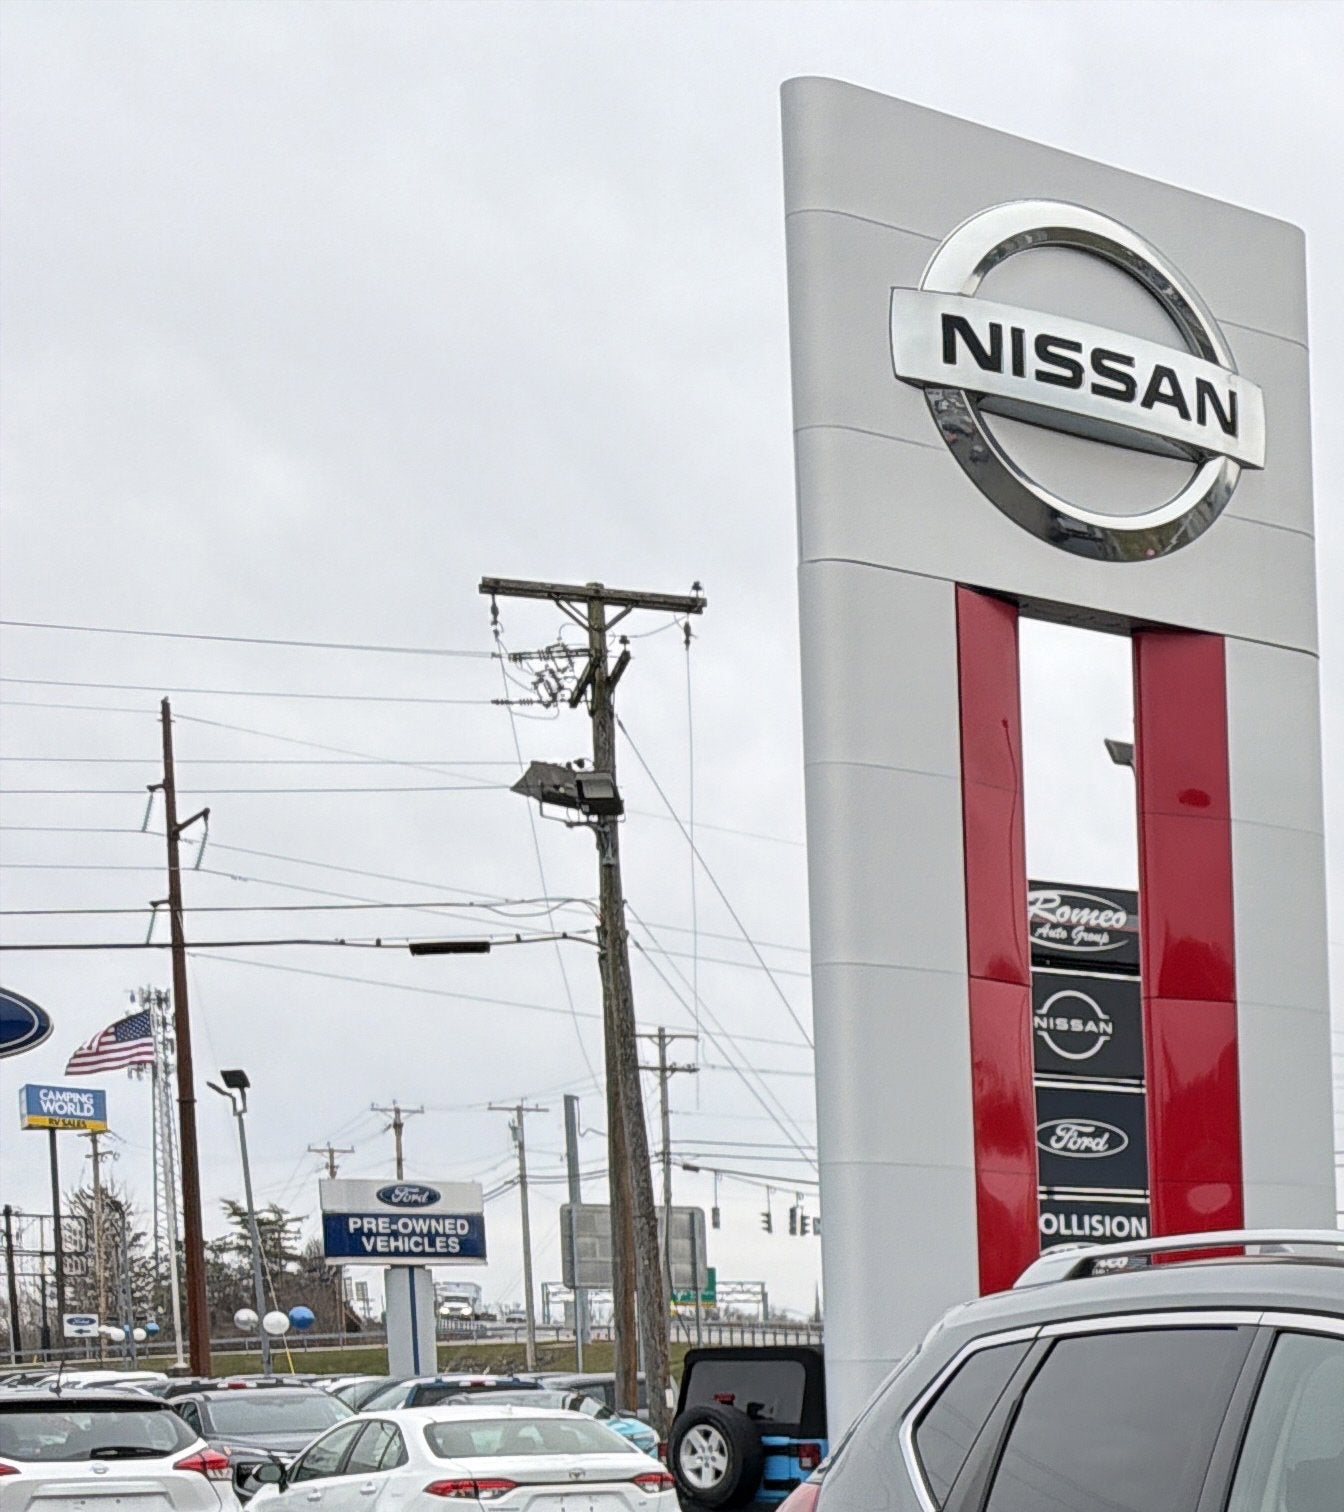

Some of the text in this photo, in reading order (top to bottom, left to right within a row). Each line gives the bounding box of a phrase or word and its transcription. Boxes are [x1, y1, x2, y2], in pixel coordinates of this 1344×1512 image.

[940, 312, 1239, 438] NISSAN
[1029, 892, 1127, 929] Romeo
[1034, 922, 1111, 947] Auto Group
[1033, 1015, 1114, 1035] NISSAN
[39, 1088, 94, 1105] CAMPING
[39, 1100, 95, 1117] WORLD
[48, 1118, 87, 1129] RV SALES
[1049, 1123, 1111, 1152] Ford
[391, 1186, 430, 1204] Ford
[348, 1217, 470, 1236] PRE-OWNED
[1039, 1212, 1149, 1239] OLLISION
[361, 1235, 461, 1254] VEHICLES
